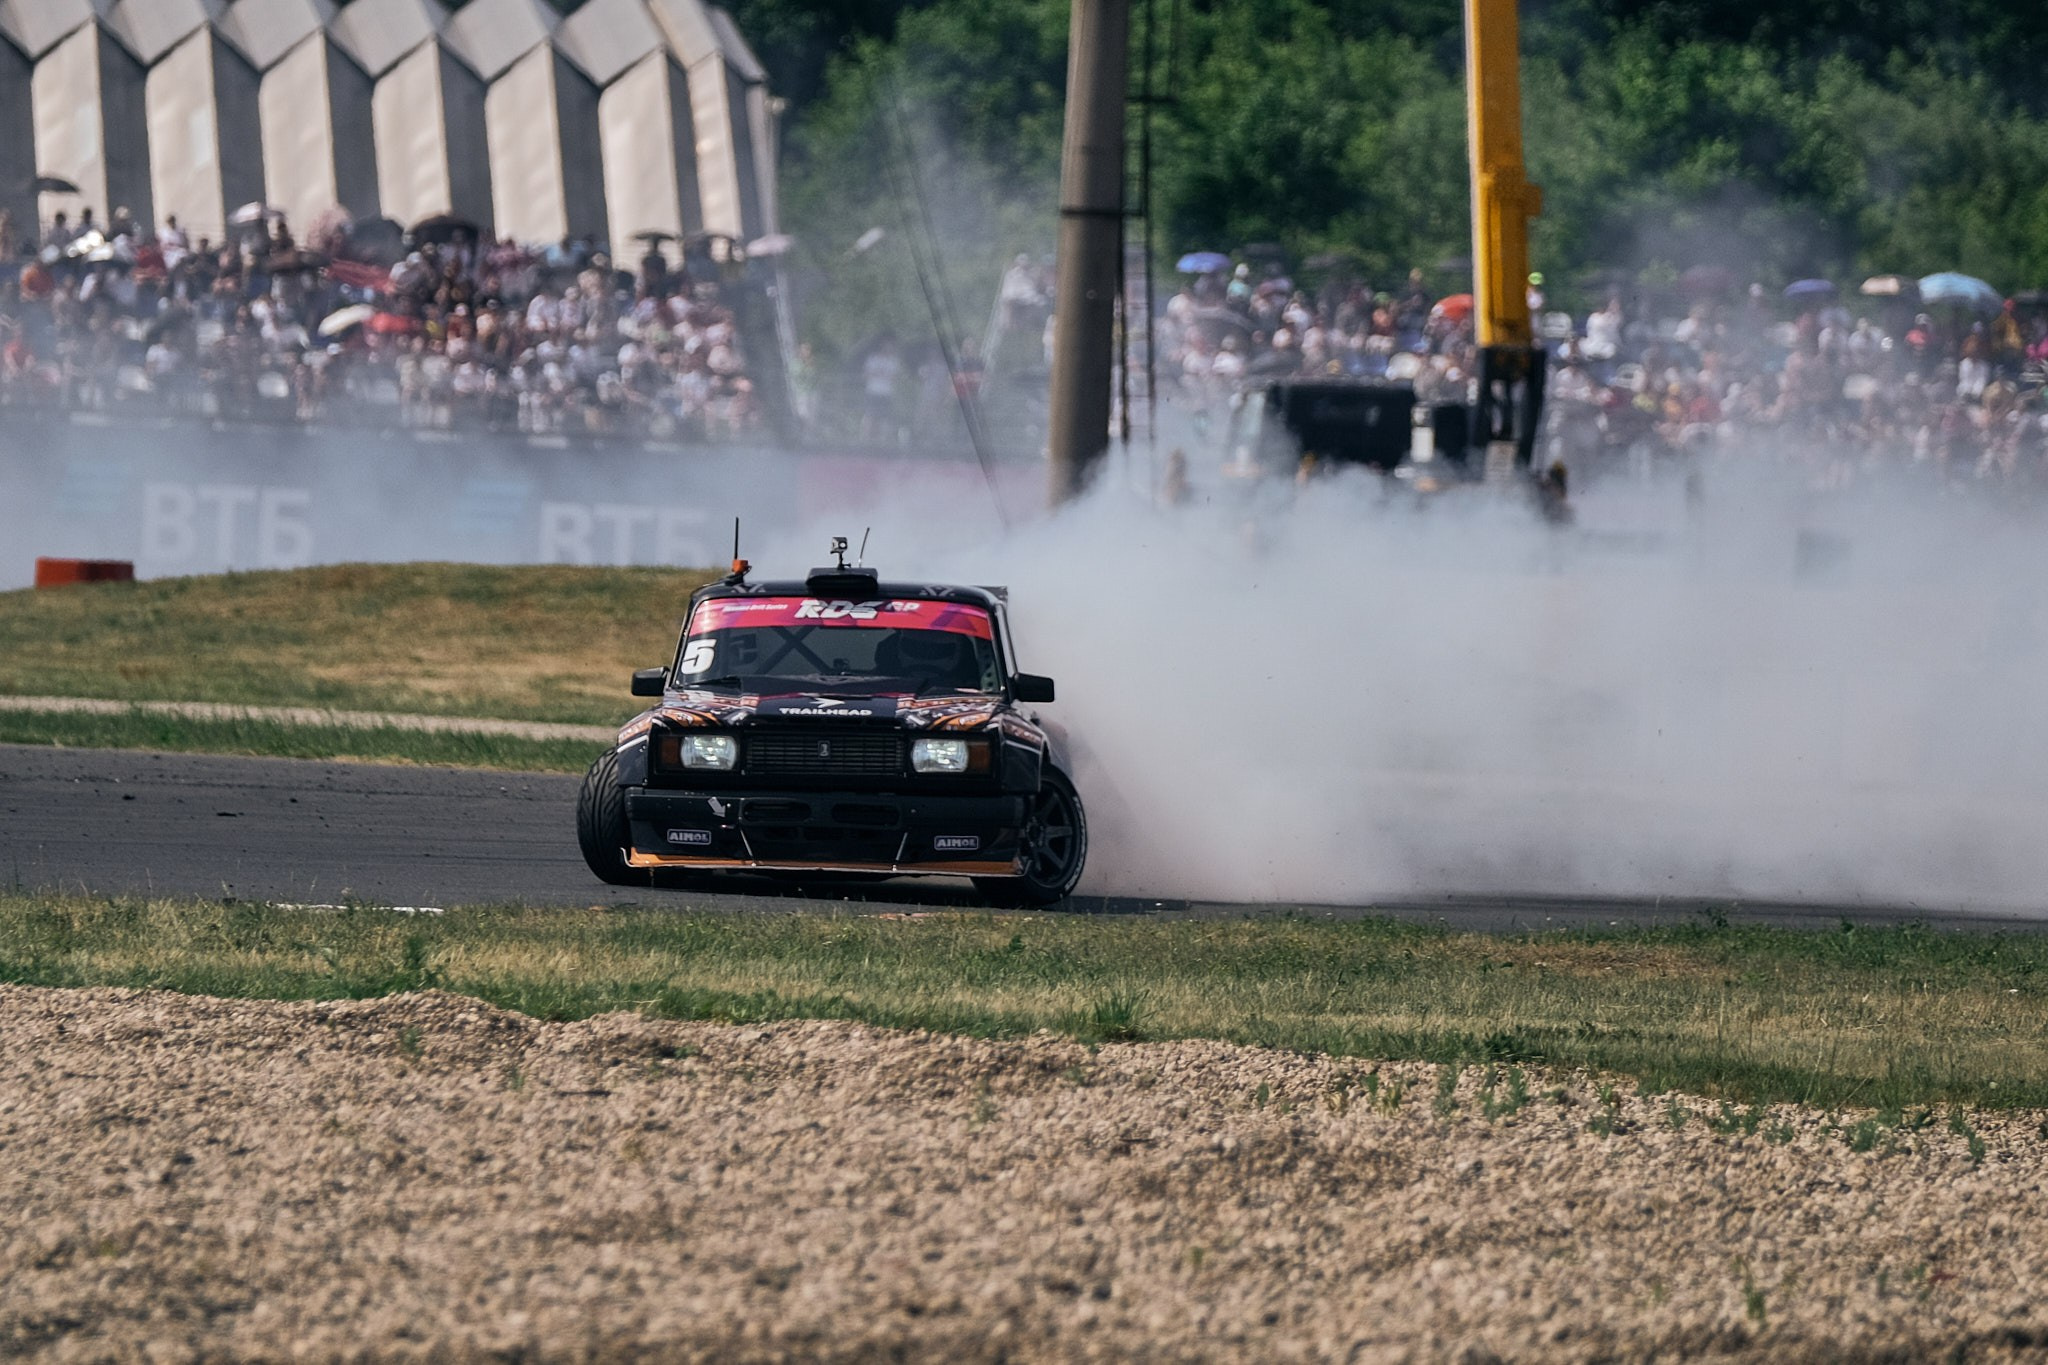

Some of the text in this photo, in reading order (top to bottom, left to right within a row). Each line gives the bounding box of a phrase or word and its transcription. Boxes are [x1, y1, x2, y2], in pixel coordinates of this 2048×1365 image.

[143, 483, 314, 562] ВТБ
[794, 599, 884, 619] RDS
[681, 638, 717, 675] 5
[779, 707, 873, 716] TRAILHEAD
[670, 832, 708, 842] AIMOL
[937, 839, 976, 848] AIMOL
